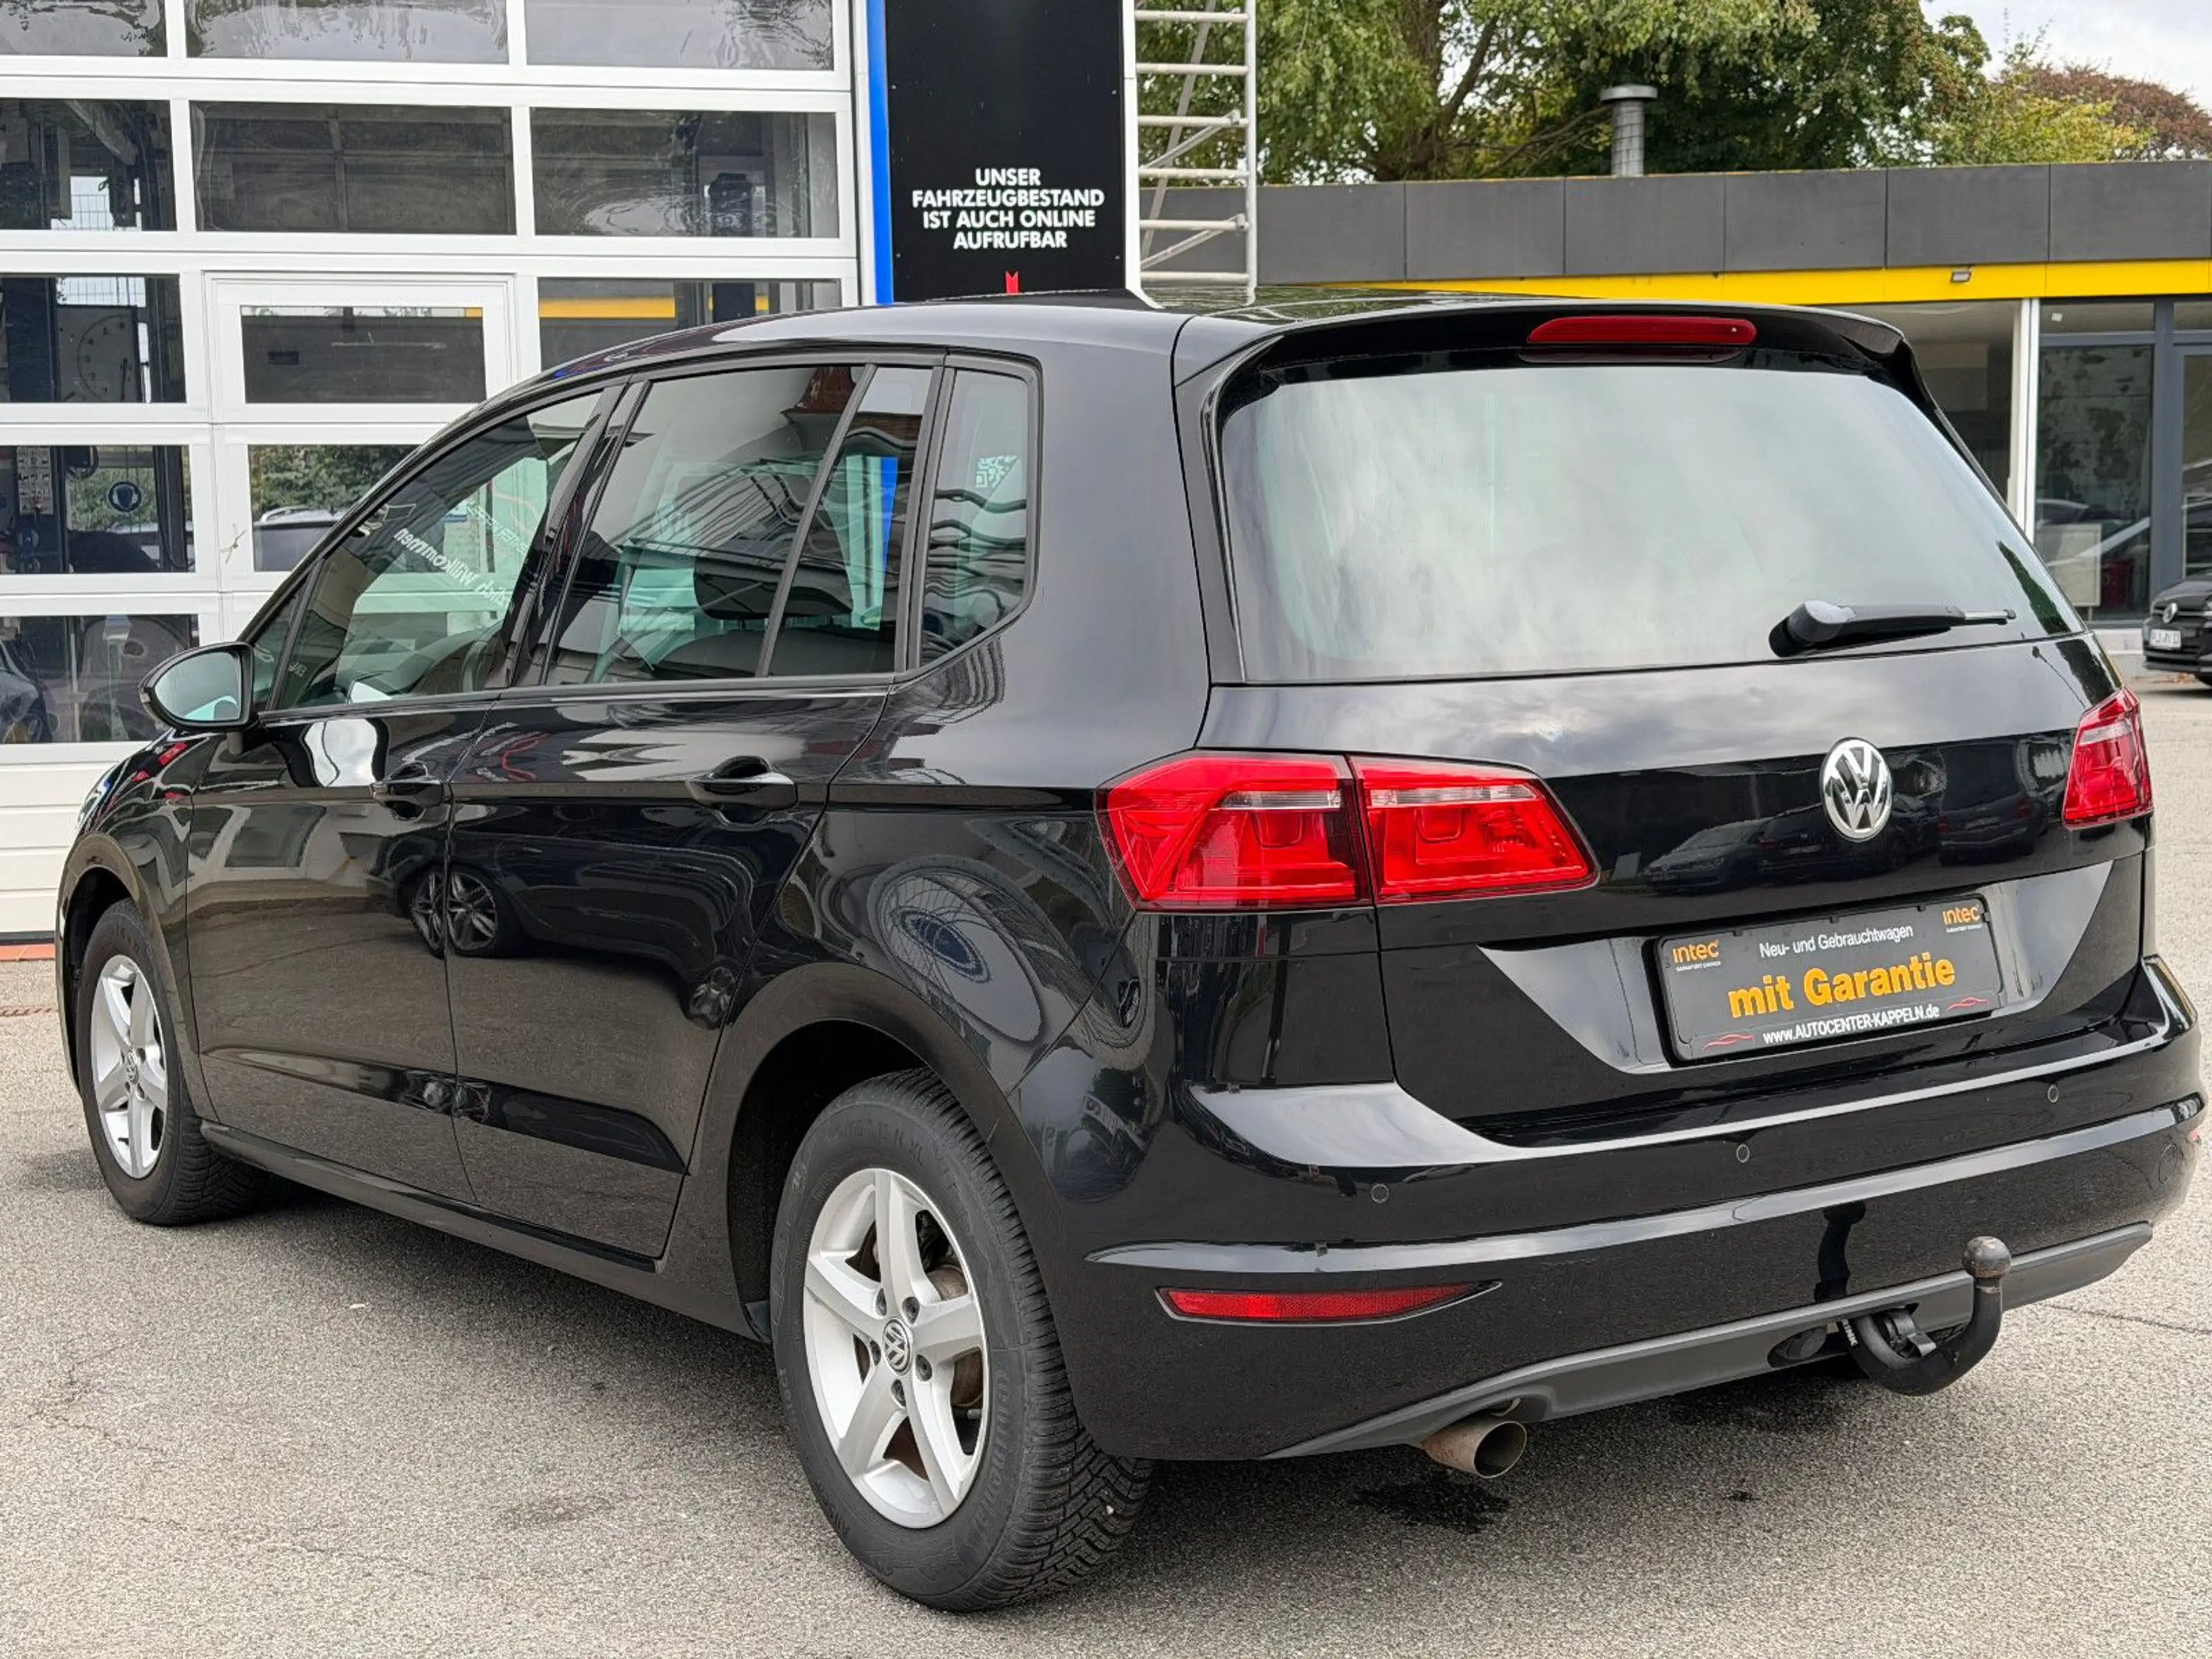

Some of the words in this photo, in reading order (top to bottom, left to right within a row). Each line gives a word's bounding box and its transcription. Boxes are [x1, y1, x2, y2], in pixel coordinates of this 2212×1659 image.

[975, 168, 1041, 186] UNSER
[912, 189, 1105, 208] FAHRZEUGBESTAND
[923, 210, 952, 229] IST
[956, 210, 1014, 229] AUCH
[1020, 210, 1096, 228] ONLINE
[953, 231, 1067, 249] AUFRUFBAR
[1942, 906, 1981, 925] intec
[1759, 942, 1790, 958] Neu-
[1793, 936, 1816, 953] und
[1817, 926, 1914, 949] Gebrauchtwagen
[1672, 941, 1719, 963] intec
[1728, 975, 1795, 1018] mit
[1802, 952, 1956, 1006] Garantie
[1762, 1003, 1940, 1044] www.AUTOCENTER-KAPPELN.de
